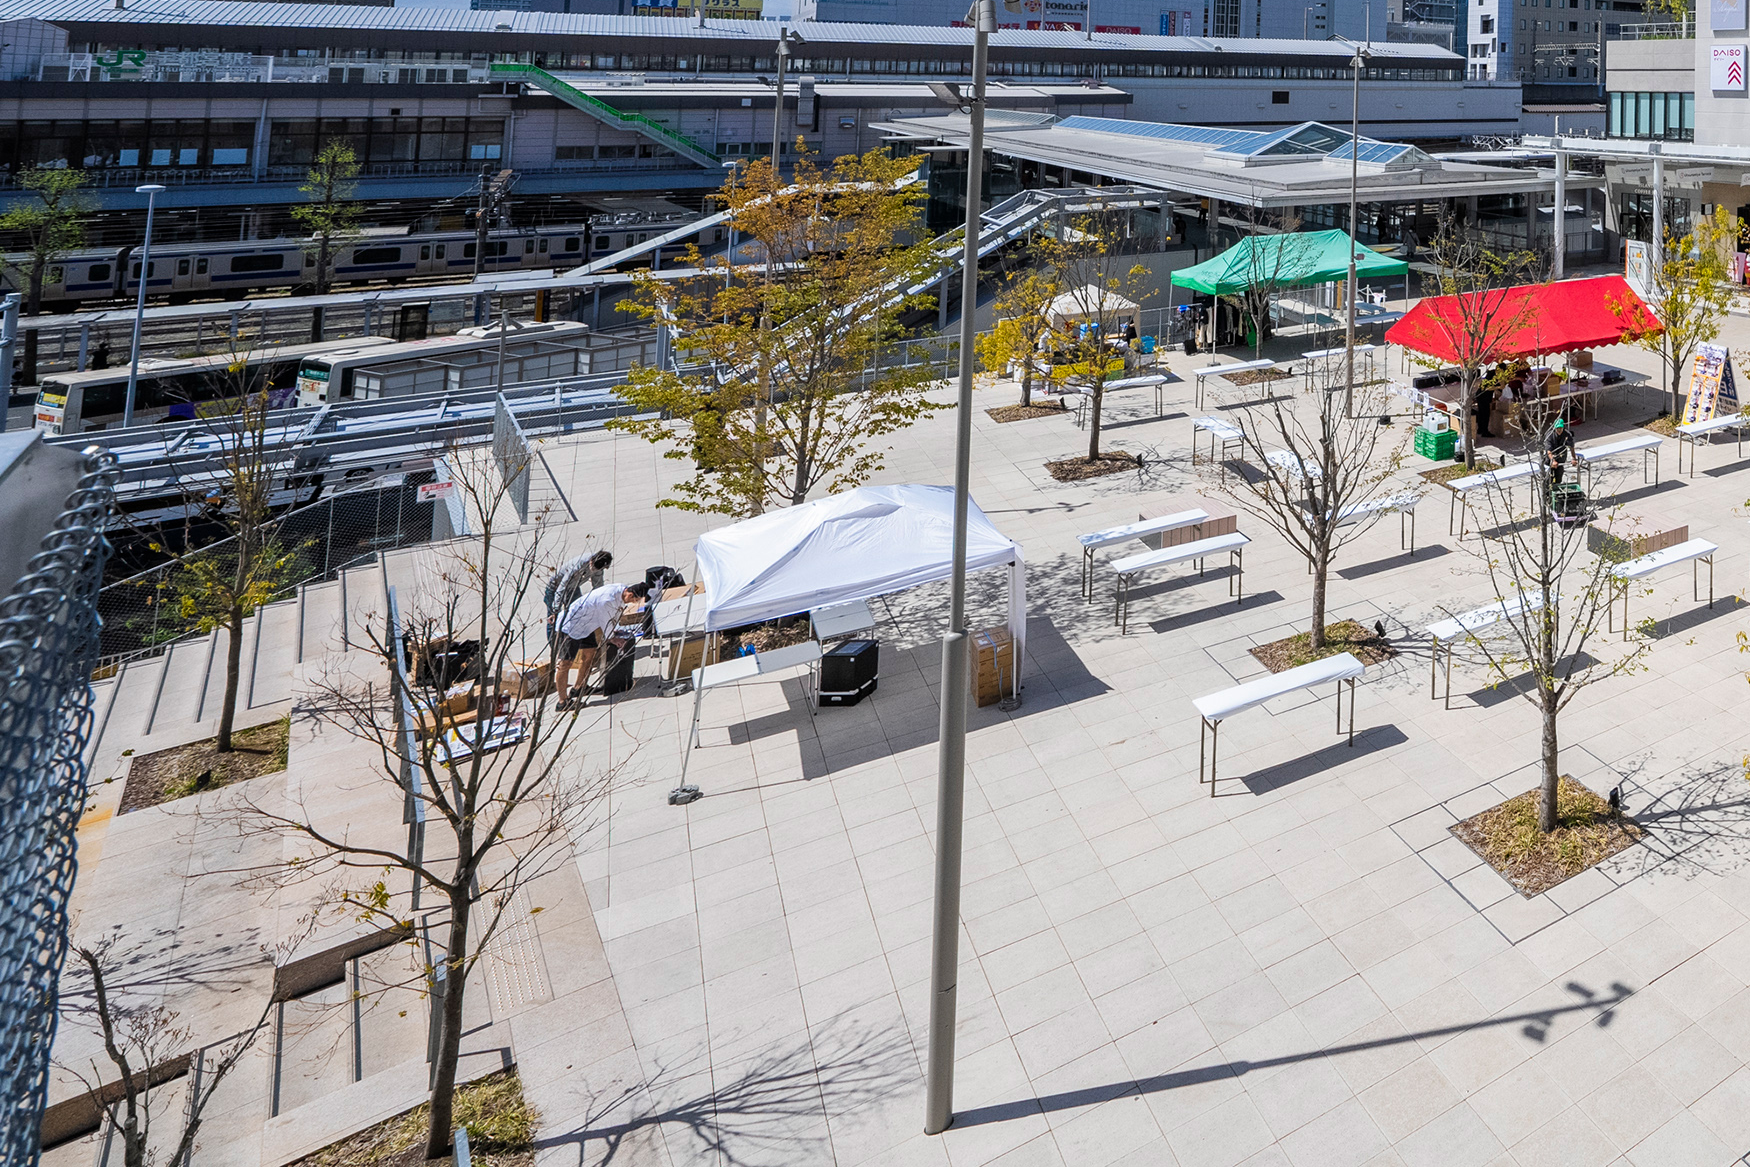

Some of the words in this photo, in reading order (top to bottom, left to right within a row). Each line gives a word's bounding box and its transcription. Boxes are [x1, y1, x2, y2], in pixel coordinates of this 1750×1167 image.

[1045, 0, 1089, 11] tonarie
[1106, 26, 1132, 35] DAISO
[1713, 49, 1741, 57] DAISO
[97, 50, 147, 67] JR
